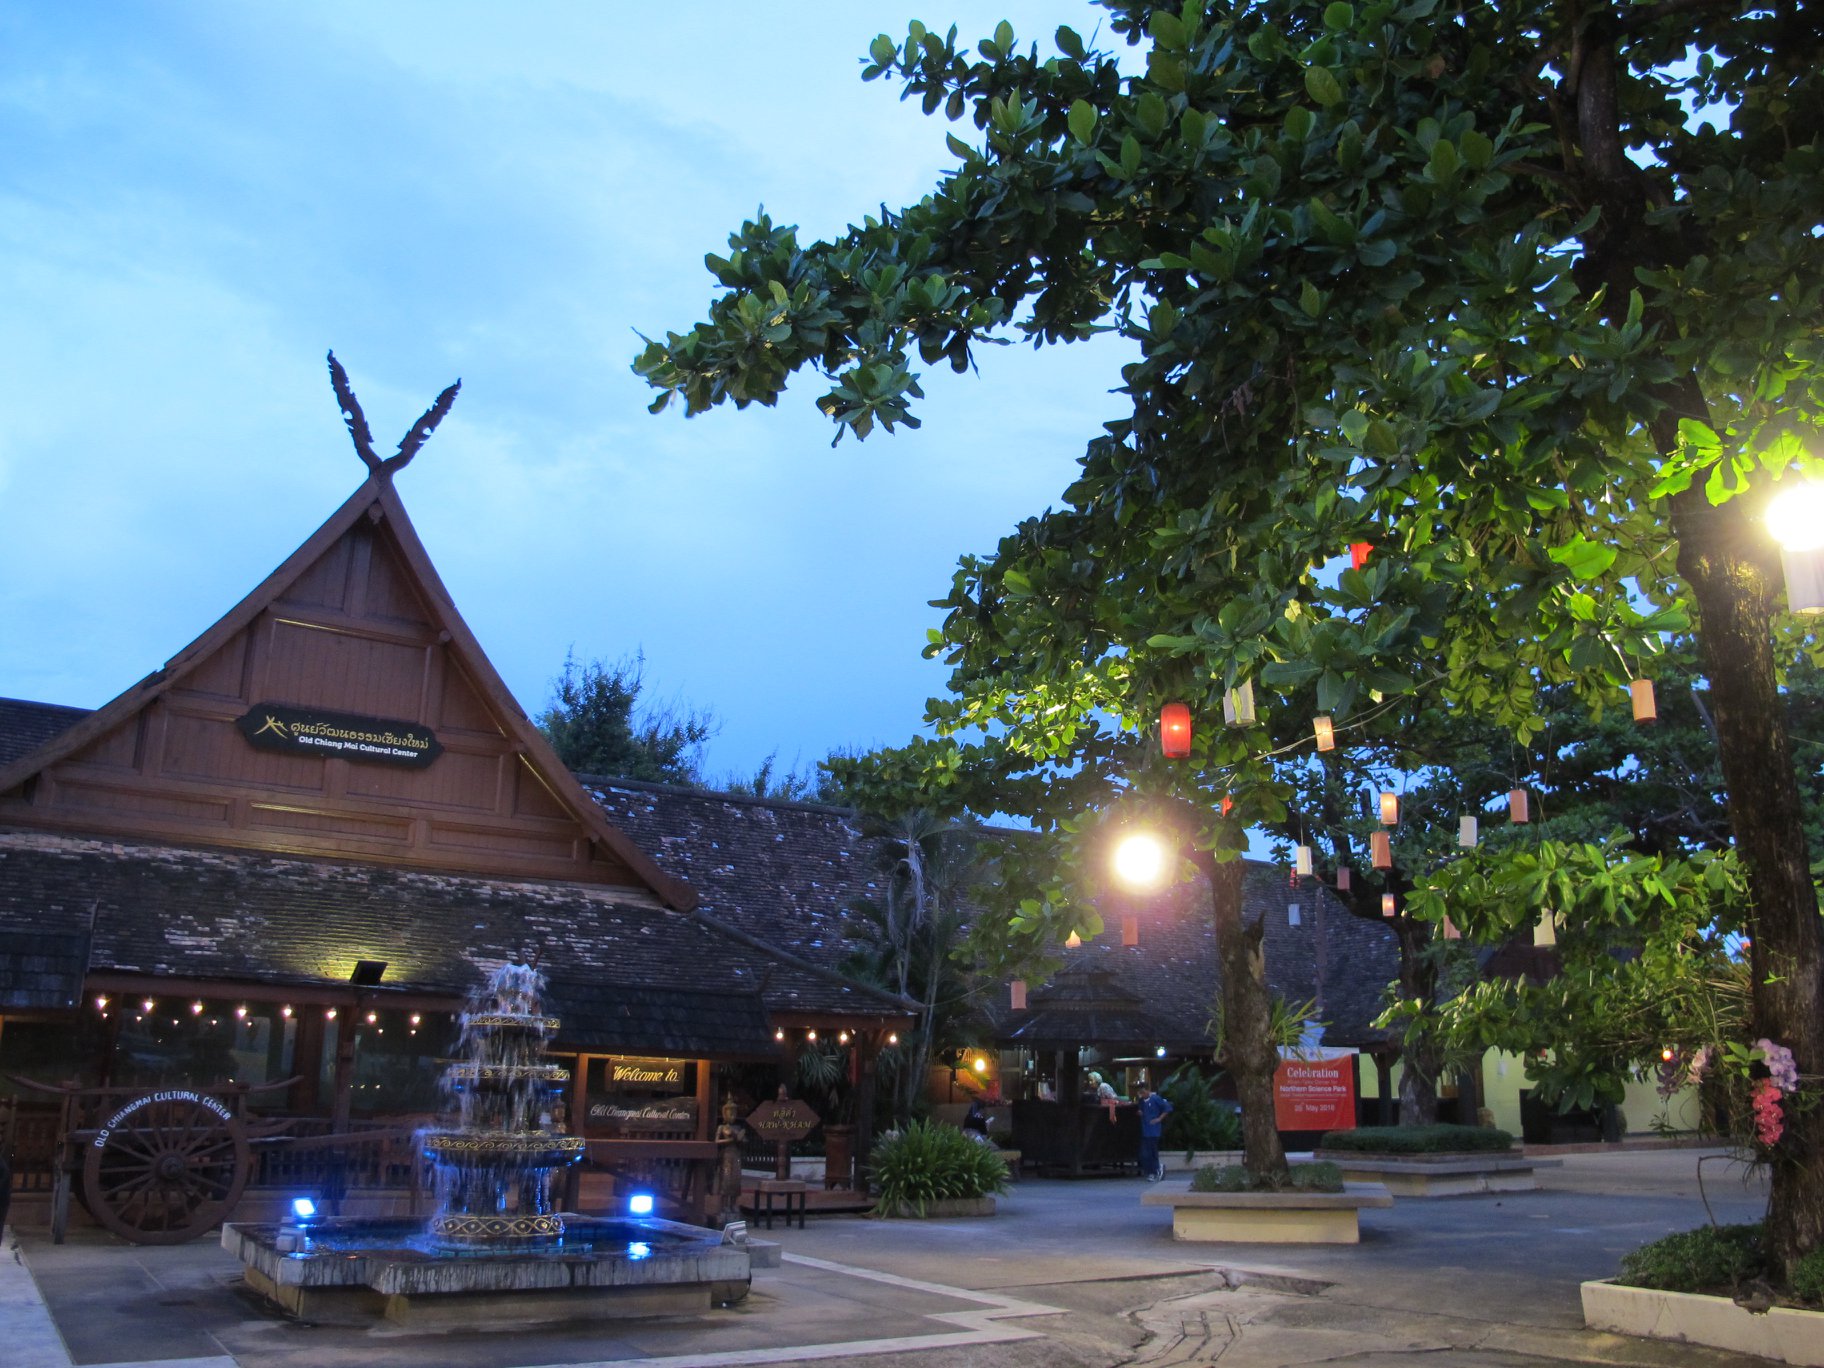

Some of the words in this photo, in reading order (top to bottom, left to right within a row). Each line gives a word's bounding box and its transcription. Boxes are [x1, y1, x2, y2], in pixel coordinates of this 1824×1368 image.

[299, 736, 313, 744] Old
[314, 737, 343, 750] Chiang
[344, 742, 359, 751] Mai
[359, 744, 391, 755] Cultural
[392, 748, 419, 758] Center
[613, 1065, 663, 1082] Welcome
[1287, 1067, 1339, 1078] Celebration
[94, 1129, 110, 1147] OLD
[107, 1096, 151, 1128] CHIANGMAI
[154, 1090, 199, 1102] CULTURAL
[202, 1096, 232, 1120] CENTER
